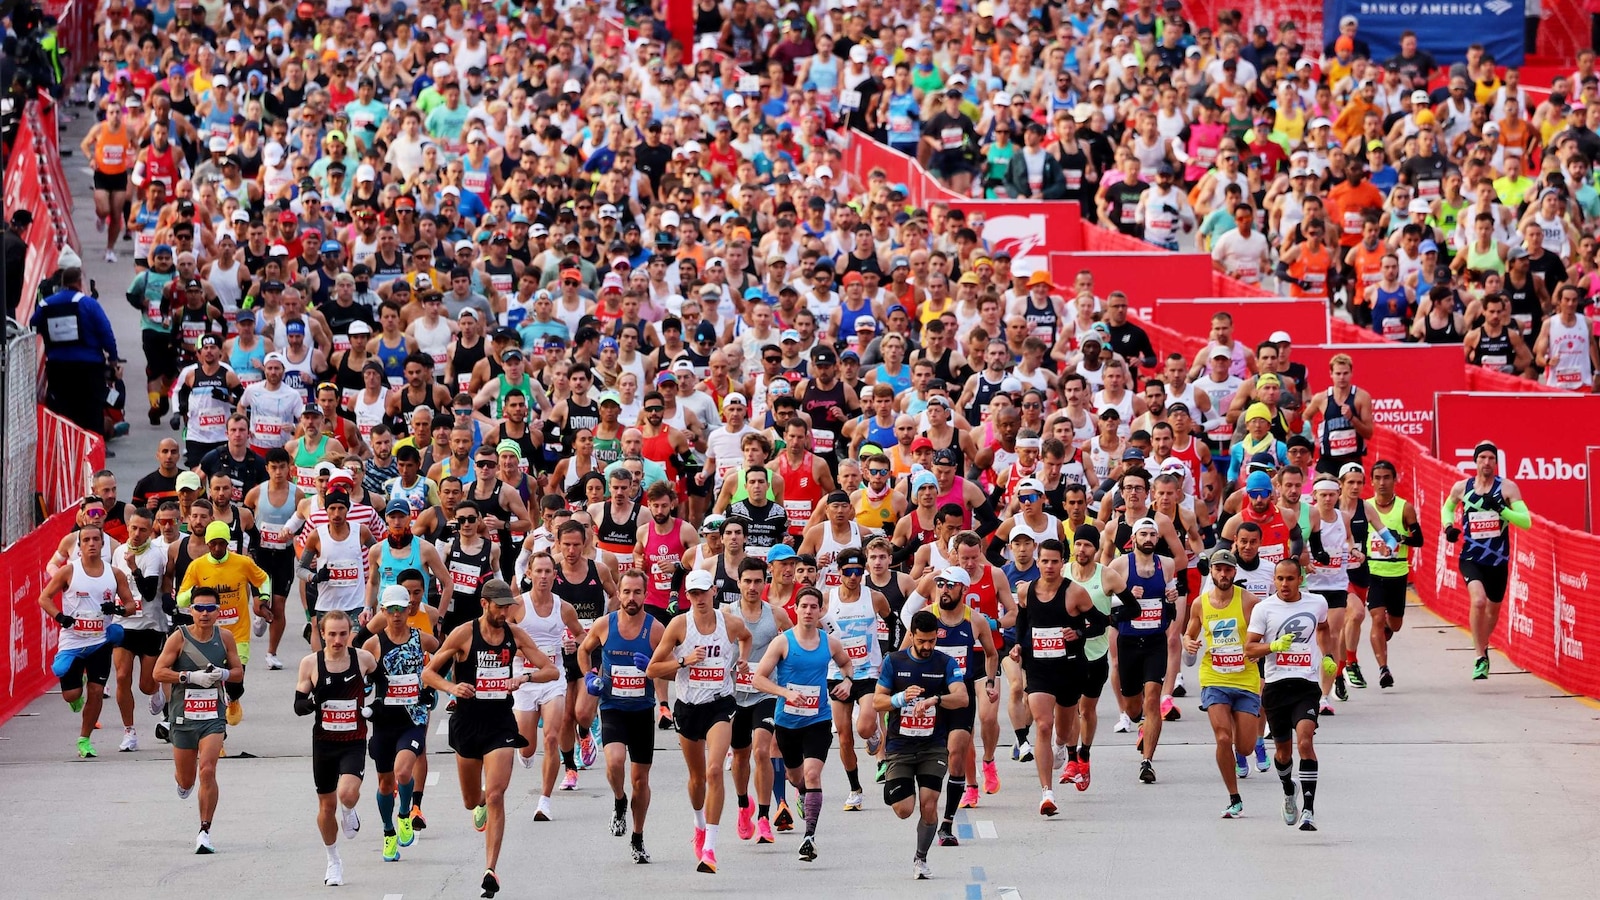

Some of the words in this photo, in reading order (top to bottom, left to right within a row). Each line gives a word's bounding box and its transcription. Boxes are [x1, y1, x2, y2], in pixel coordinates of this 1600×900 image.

[1361, 3, 1398, 15] BANK
[1400, 3, 1418, 15] OF
[1420, 3, 1482, 15] AMERICA
[593, 449, 618, 462] EXICO
[790, 510, 811, 518] 25440
[329, 569, 335, 578] A
[336, 568, 358, 578] 3169
[449, 571, 455, 580] A
[455, 572, 478, 585] 3196
[219, 607, 237, 617] 1081
[74, 619, 81, 628] A
[82, 619, 103, 630] 1010
[1033, 638, 1040, 648] A
[1041, 638, 1064, 648] 5073
[476, 650, 498, 661] WEST
[1219, 654, 1244, 664] 10030
[1277, 654, 1285, 663] A
[1286, 654, 1311, 664] 4070
[476, 660, 502, 668] VALLEY
[690, 669, 696, 677] A
[697, 668, 723, 678] 20158
[736, 673, 743, 681] A
[476, 680, 484, 689] A
[485, 680, 507, 689] 2012
[612, 677, 619, 685] A
[619, 677, 645, 686] 21063
[392, 685, 418, 695] 25284
[185, 701, 193, 709] A
[193, 700, 217, 709] 20115
[322, 711, 329, 719] A
[330, 710, 356, 720] 18054
[901, 716, 909, 725] A
[911, 716, 935, 726] 1122
